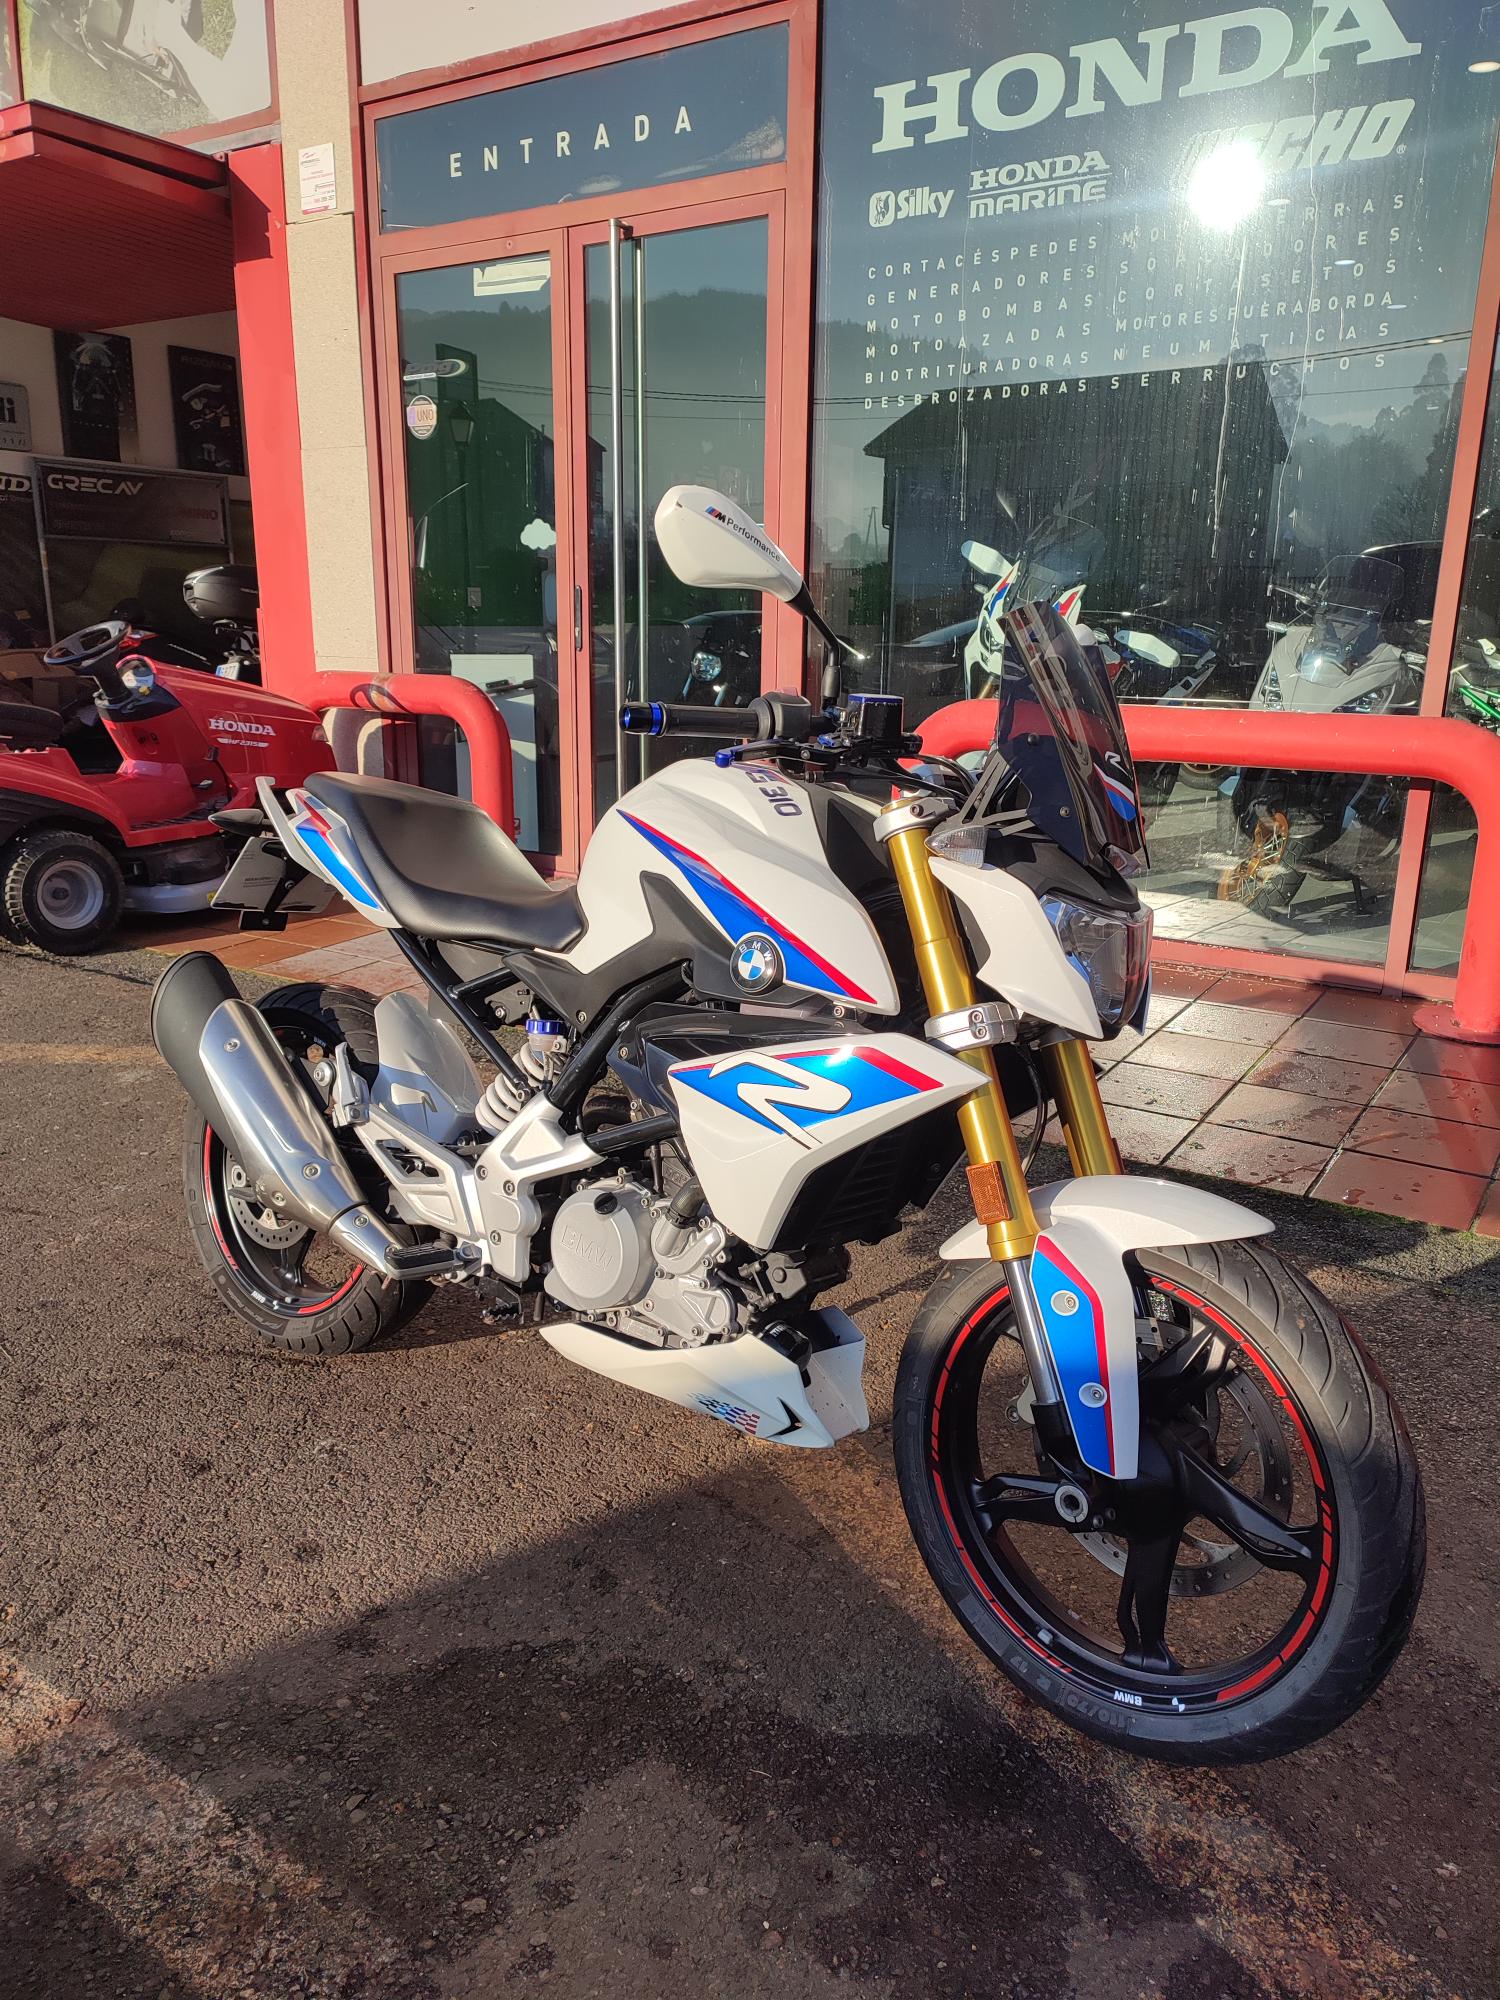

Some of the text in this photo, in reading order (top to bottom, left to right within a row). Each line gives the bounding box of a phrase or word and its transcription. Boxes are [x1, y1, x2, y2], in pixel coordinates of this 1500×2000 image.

[872, 0, 1421, 153] HONDA
[450, 106, 692, 177] ENTRADA
[971, 150, 1110, 191] HONDA
[897, 186, 955, 220] Silky
[969, 180, 1106, 218] MARINE
[868, 235, 1097, 279] CORTACÉSPEDES
[867, 265, 1095, 306] GENERADORES
[1117, 259, 1396, 303] CORTASETOS
[867, 295, 1092, 333] MOTOBOMBAS
[866, 323, 1091, 358] MOTOAZADAS
[865, 351, 1088, 384] BIOTRITURADORAS
[1110, 353, 1385, 389] SERRUCHOS
[864, 380, 1087, 410] DESBROZADORAS
[47, 474, 144, 496] GRECAV
[726, 517, 781, 562] Performance
[208, 717, 277, 737] HONDA
[738, 940, 774, 962] BMW
[708, 1050, 853, 1151] R
[560, 1225, 615, 1272] BMW
[1113, 1689, 1143, 1707] BMW
